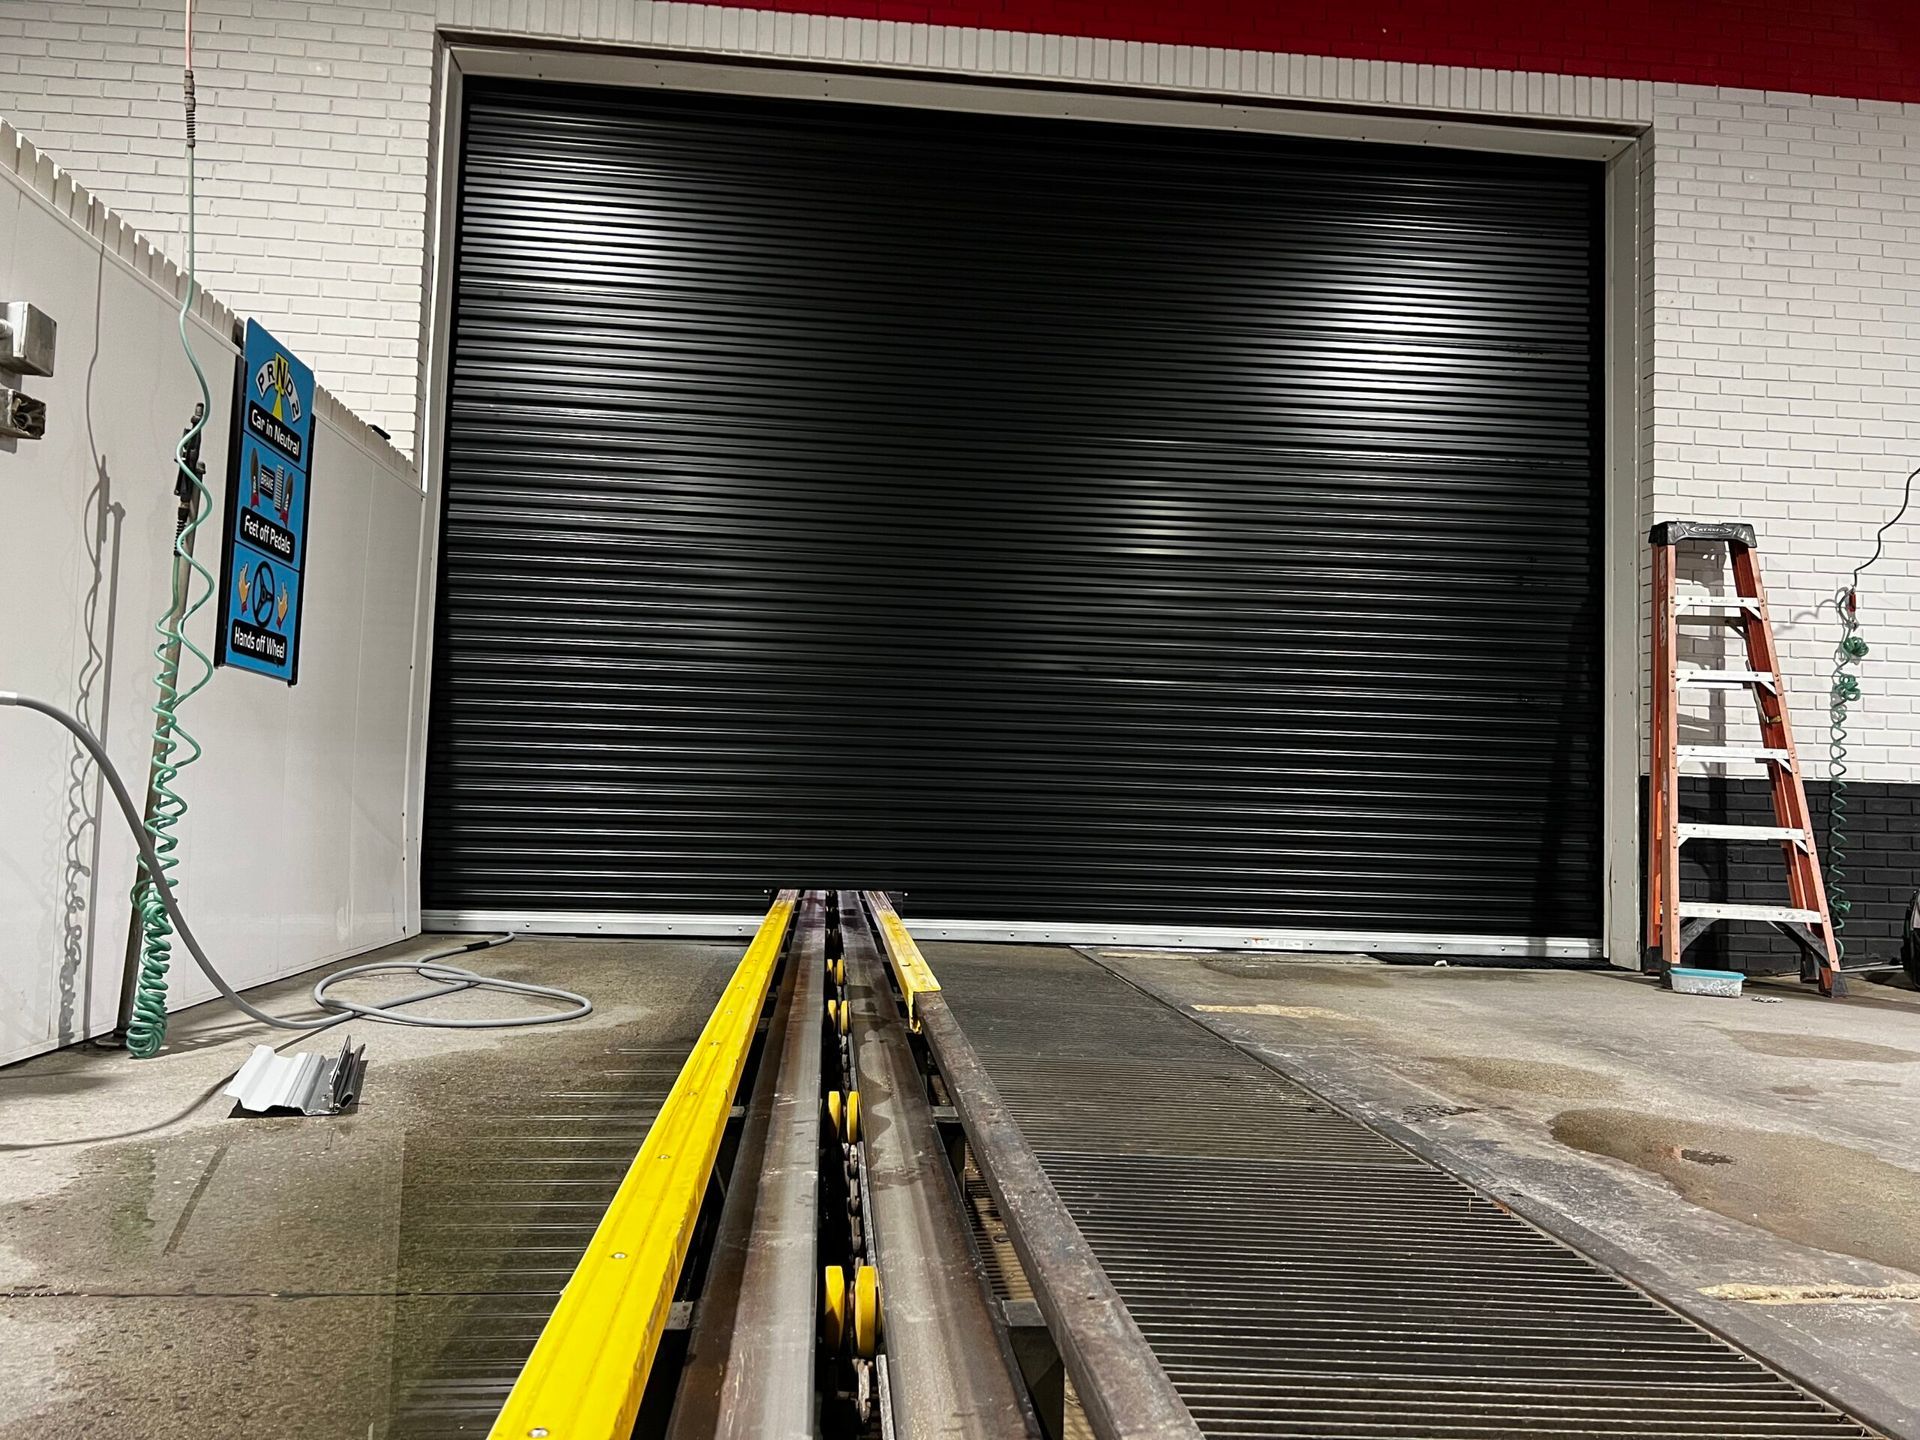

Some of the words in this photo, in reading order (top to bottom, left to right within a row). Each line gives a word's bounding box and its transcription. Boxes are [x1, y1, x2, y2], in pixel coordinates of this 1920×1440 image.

[251, 409, 265, 430] Car
[265, 419, 273, 438] in
[274, 424, 300, 456] Neutral
[244, 515, 259, 538] Feet
[259, 524, 270, 543] off
[270, 528, 291, 554] Pedals
[233, 626, 255, 650] Hands
[255, 635, 266, 653] off
[266, 637, 285, 658] Wheel
